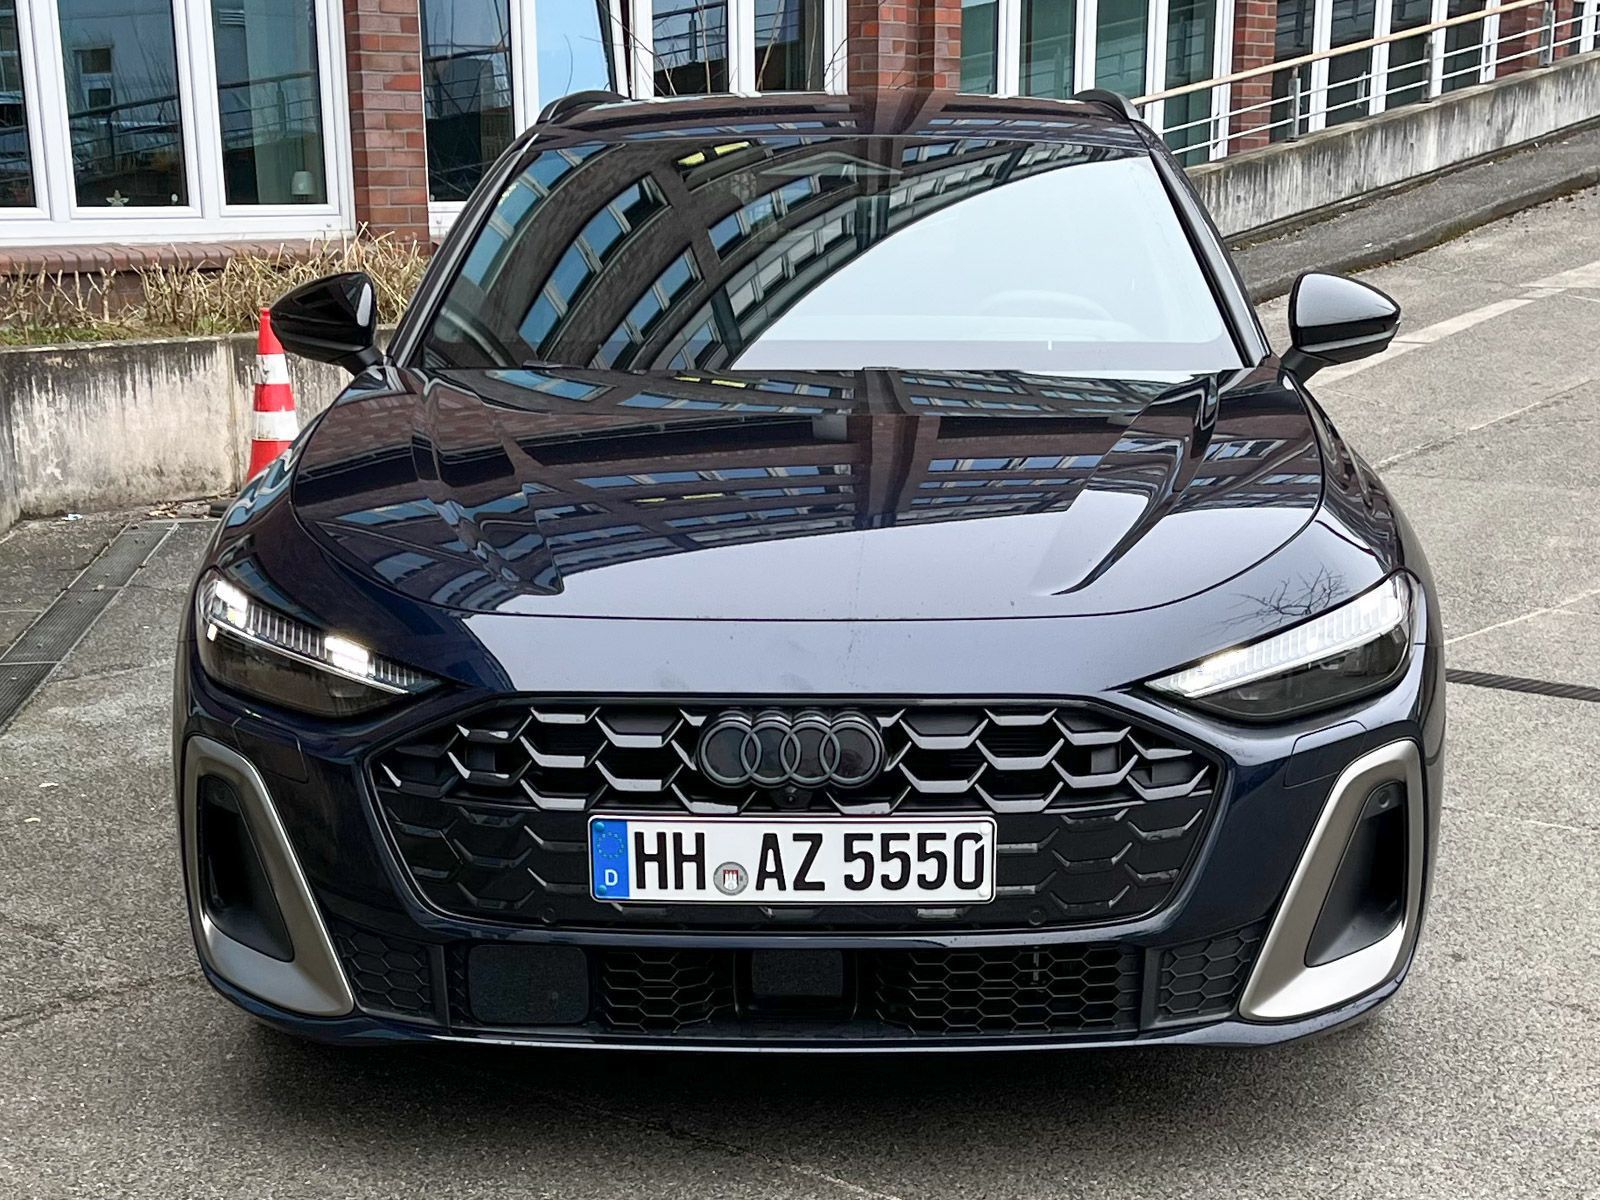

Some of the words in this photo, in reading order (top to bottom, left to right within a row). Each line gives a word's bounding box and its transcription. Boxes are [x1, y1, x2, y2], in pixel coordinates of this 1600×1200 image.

[603, 869, 618, 887] D
[634, 831, 706, 890] HH
[755, 833, 826, 891] AZ
[843, 832, 985, 891] 5550
